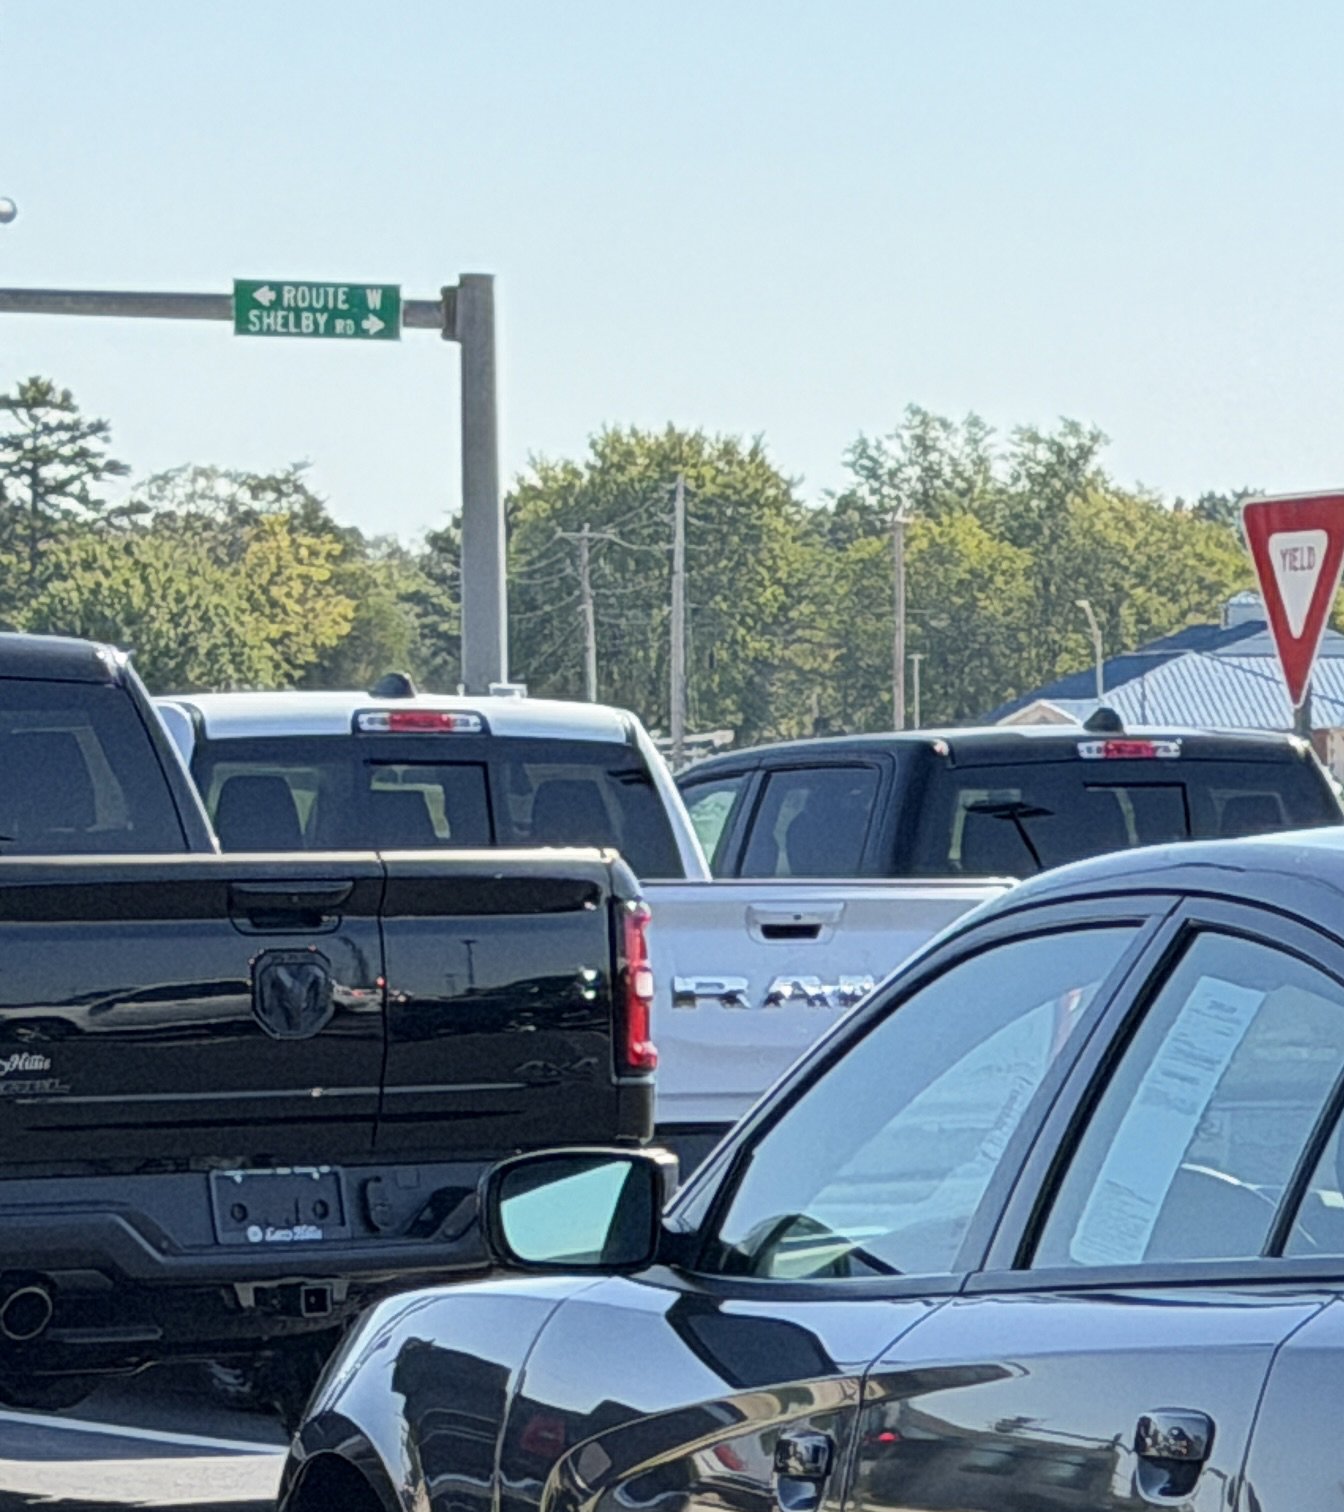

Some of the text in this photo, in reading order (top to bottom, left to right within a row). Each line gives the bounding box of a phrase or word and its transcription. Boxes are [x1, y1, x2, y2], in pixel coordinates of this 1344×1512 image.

[282, 285, 382, 310] ROUTE W
[248, 309, 355, 334] SHELBY RD
[1280, 545, 1315, 573] YIELD
